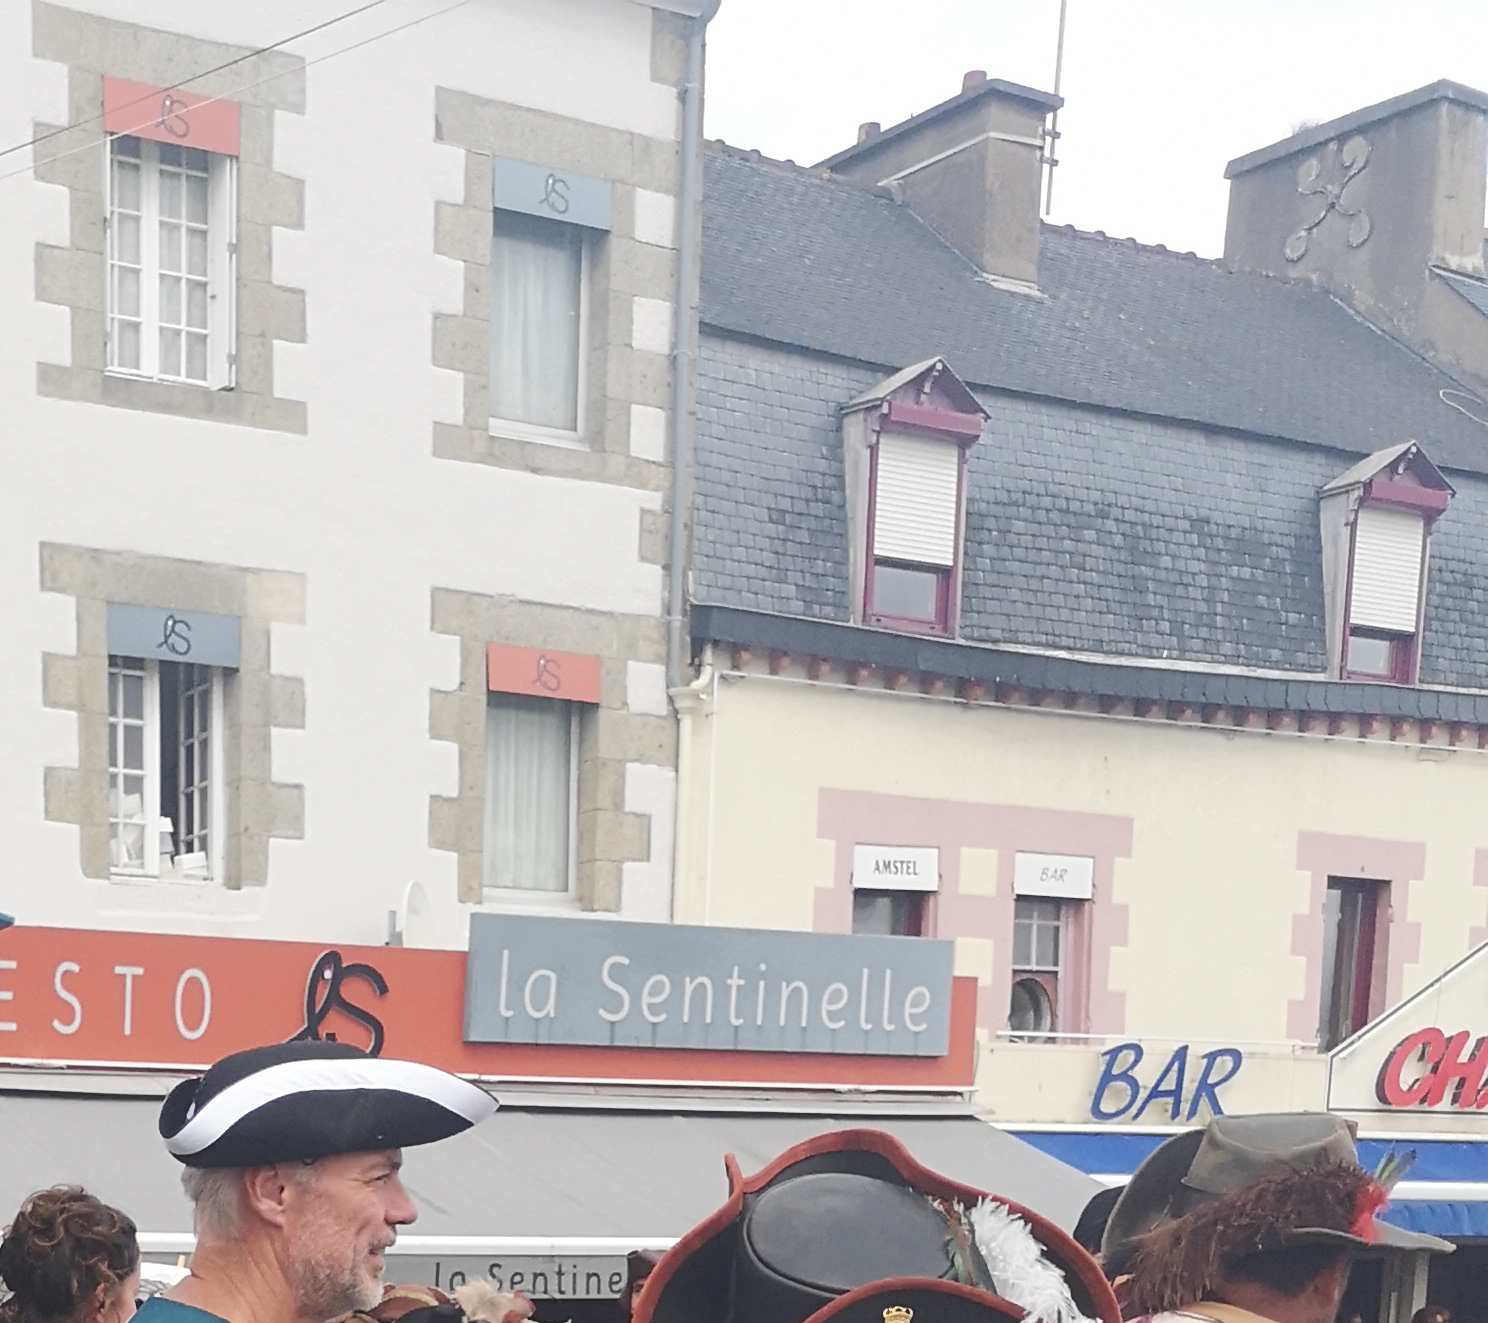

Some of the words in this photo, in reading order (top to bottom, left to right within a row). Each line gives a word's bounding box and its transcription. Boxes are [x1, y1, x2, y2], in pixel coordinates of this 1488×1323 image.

[873, 859, 919, 876] AMSTEL
[1039, 867, 1068, 883] BAR
[498, 949, 558, 1020] la
[598, 955, 932, 1032] Sentinelle
[1090, 1043, 1243, 1121] BAR
[1377, 1026, 1488, 1109] CH
